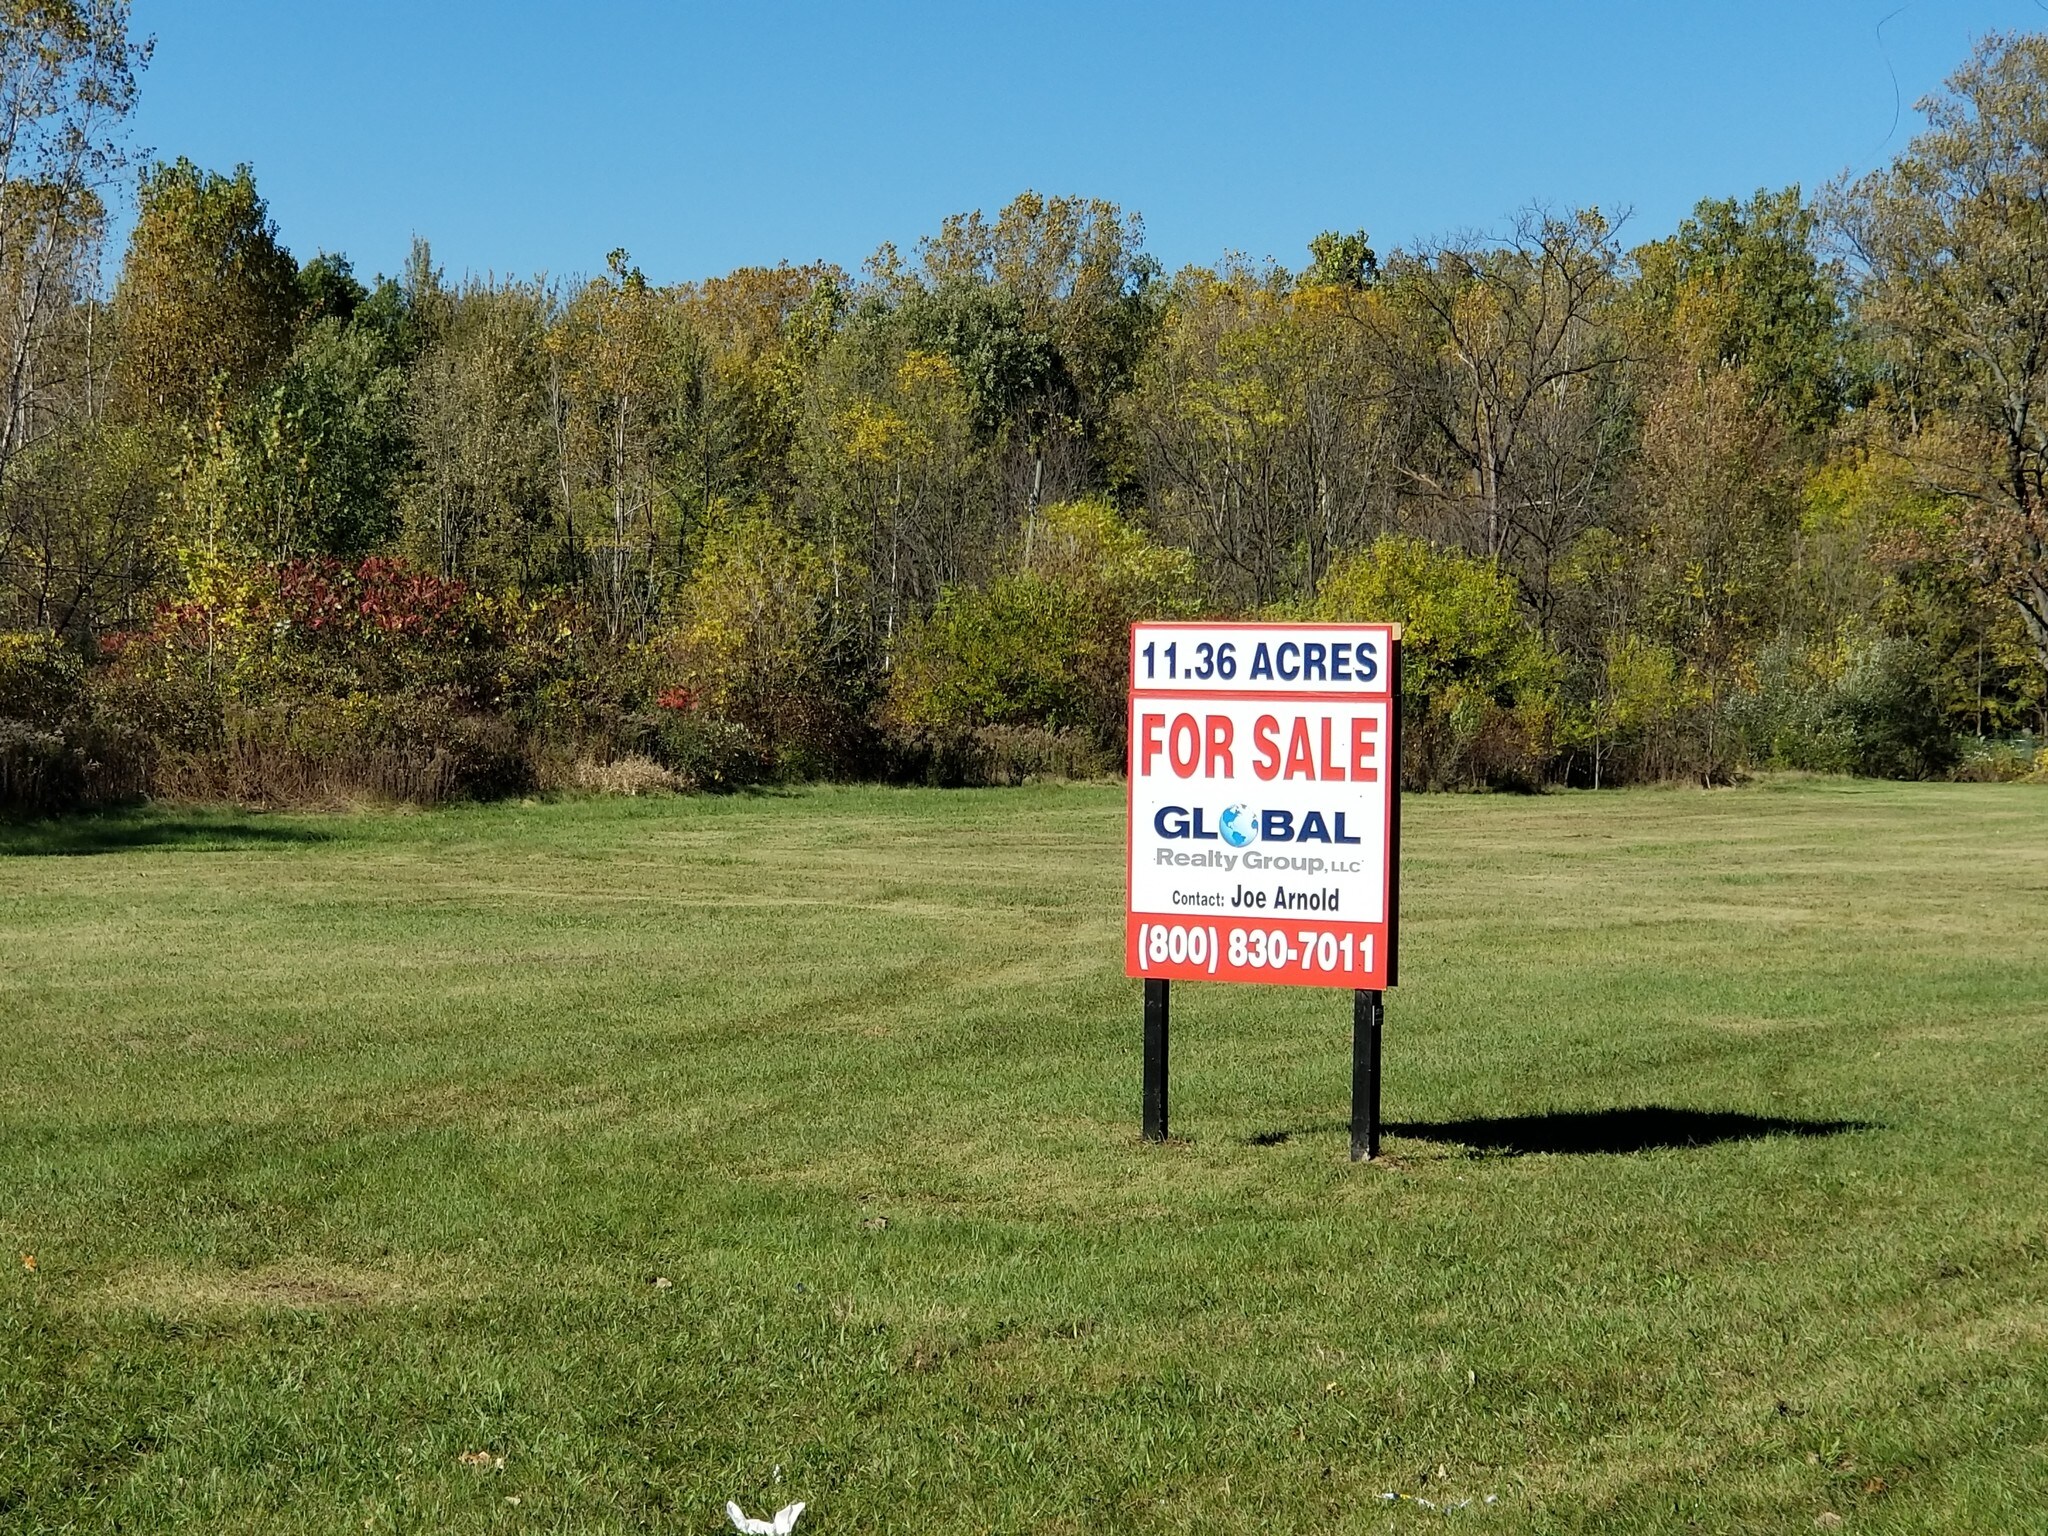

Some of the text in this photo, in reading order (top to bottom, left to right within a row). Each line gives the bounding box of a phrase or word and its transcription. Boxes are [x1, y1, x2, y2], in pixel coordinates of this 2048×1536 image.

[1142, 641, 1378, 682] 11.36 ACRES
[1141, 712, 1378, 782] FOR SALE
[1156, 848, 1361, 875] Realty Group, LLC
[1172, 884, 1340, 912] Contact: Joe Arnold
[1138, 923, 1374, 974] (800) 830-7011
